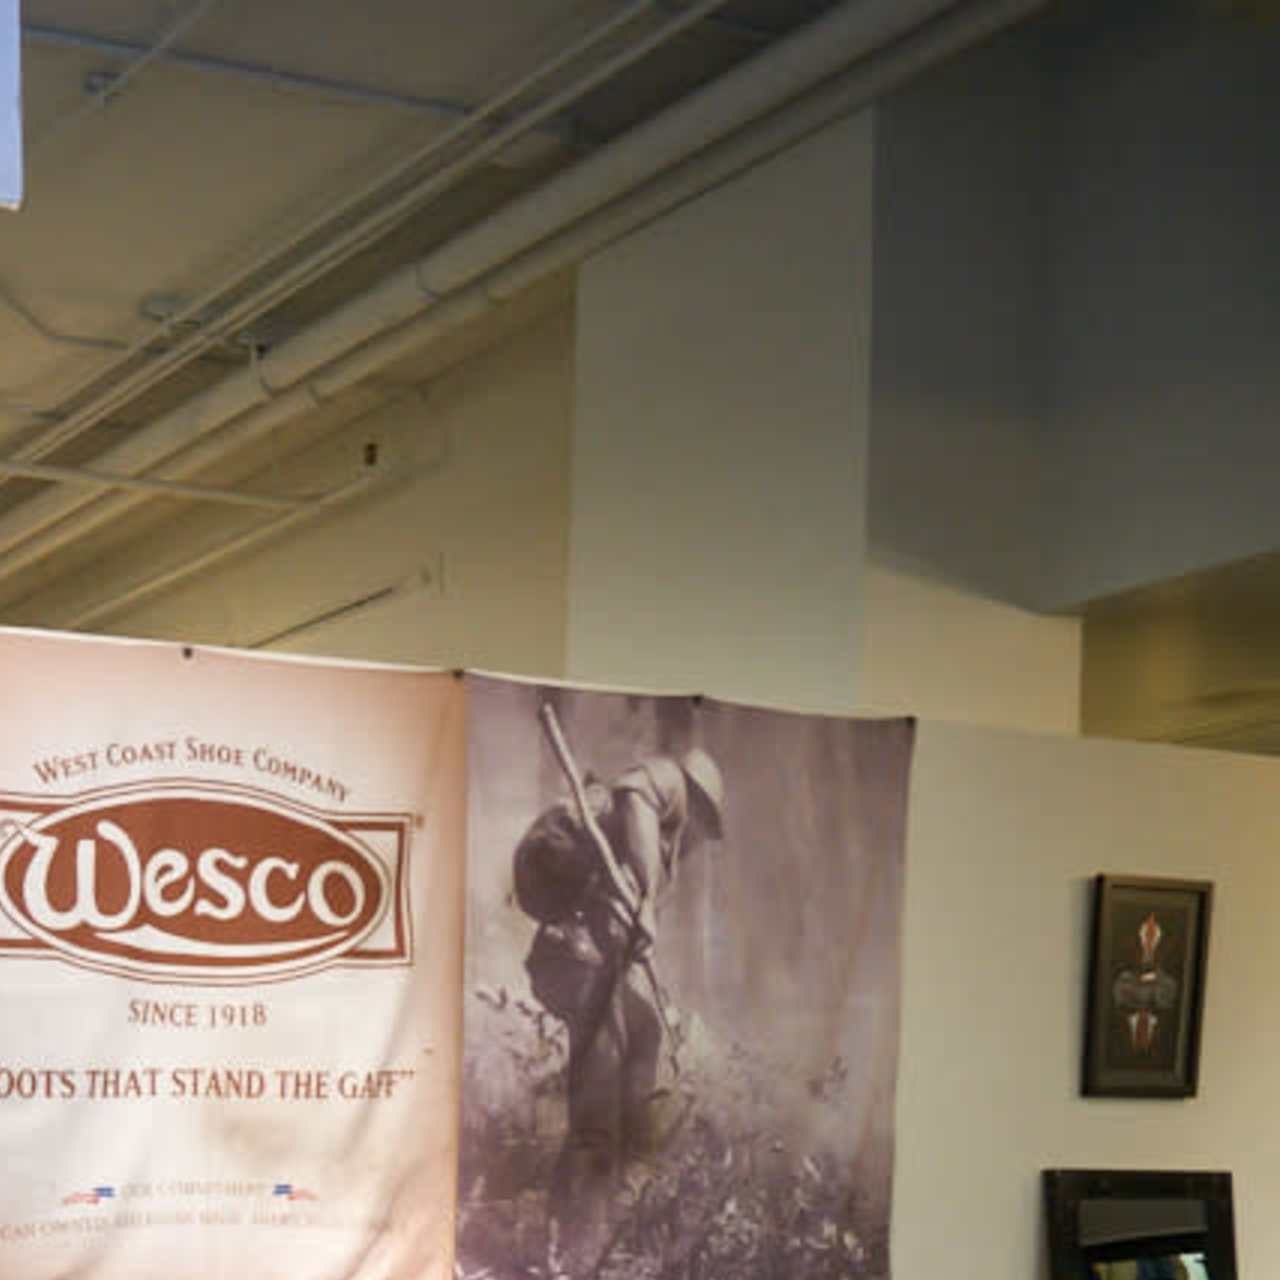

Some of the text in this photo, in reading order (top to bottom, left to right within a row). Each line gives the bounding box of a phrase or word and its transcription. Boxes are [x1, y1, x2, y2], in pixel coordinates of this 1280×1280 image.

[128, 998, 267, 1027] SINCE 1918
[85, 1068, 160, 1098] THAT
[171, 1067, 265, 1099] STAND
[274, 1070, 328, 1099] THE
